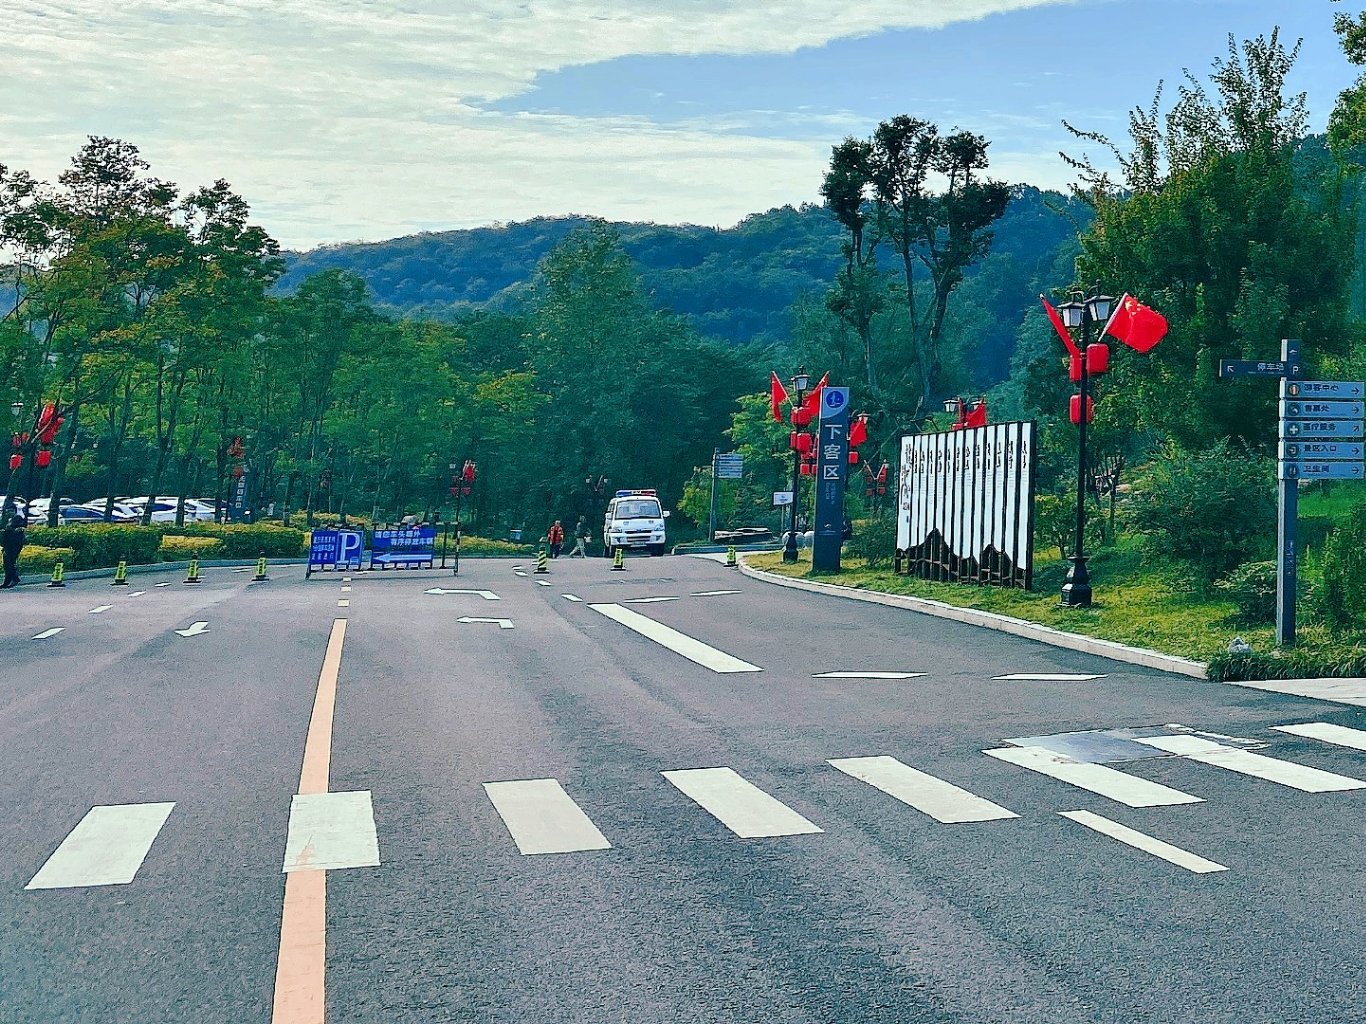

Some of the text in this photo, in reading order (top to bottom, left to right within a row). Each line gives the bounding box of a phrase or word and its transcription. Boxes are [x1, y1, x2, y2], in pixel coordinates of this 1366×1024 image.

[1257, 362, 1284, 371] 停车场
[824, 424, 842, 479] 下客区
[337, 532, 360, 564] P
